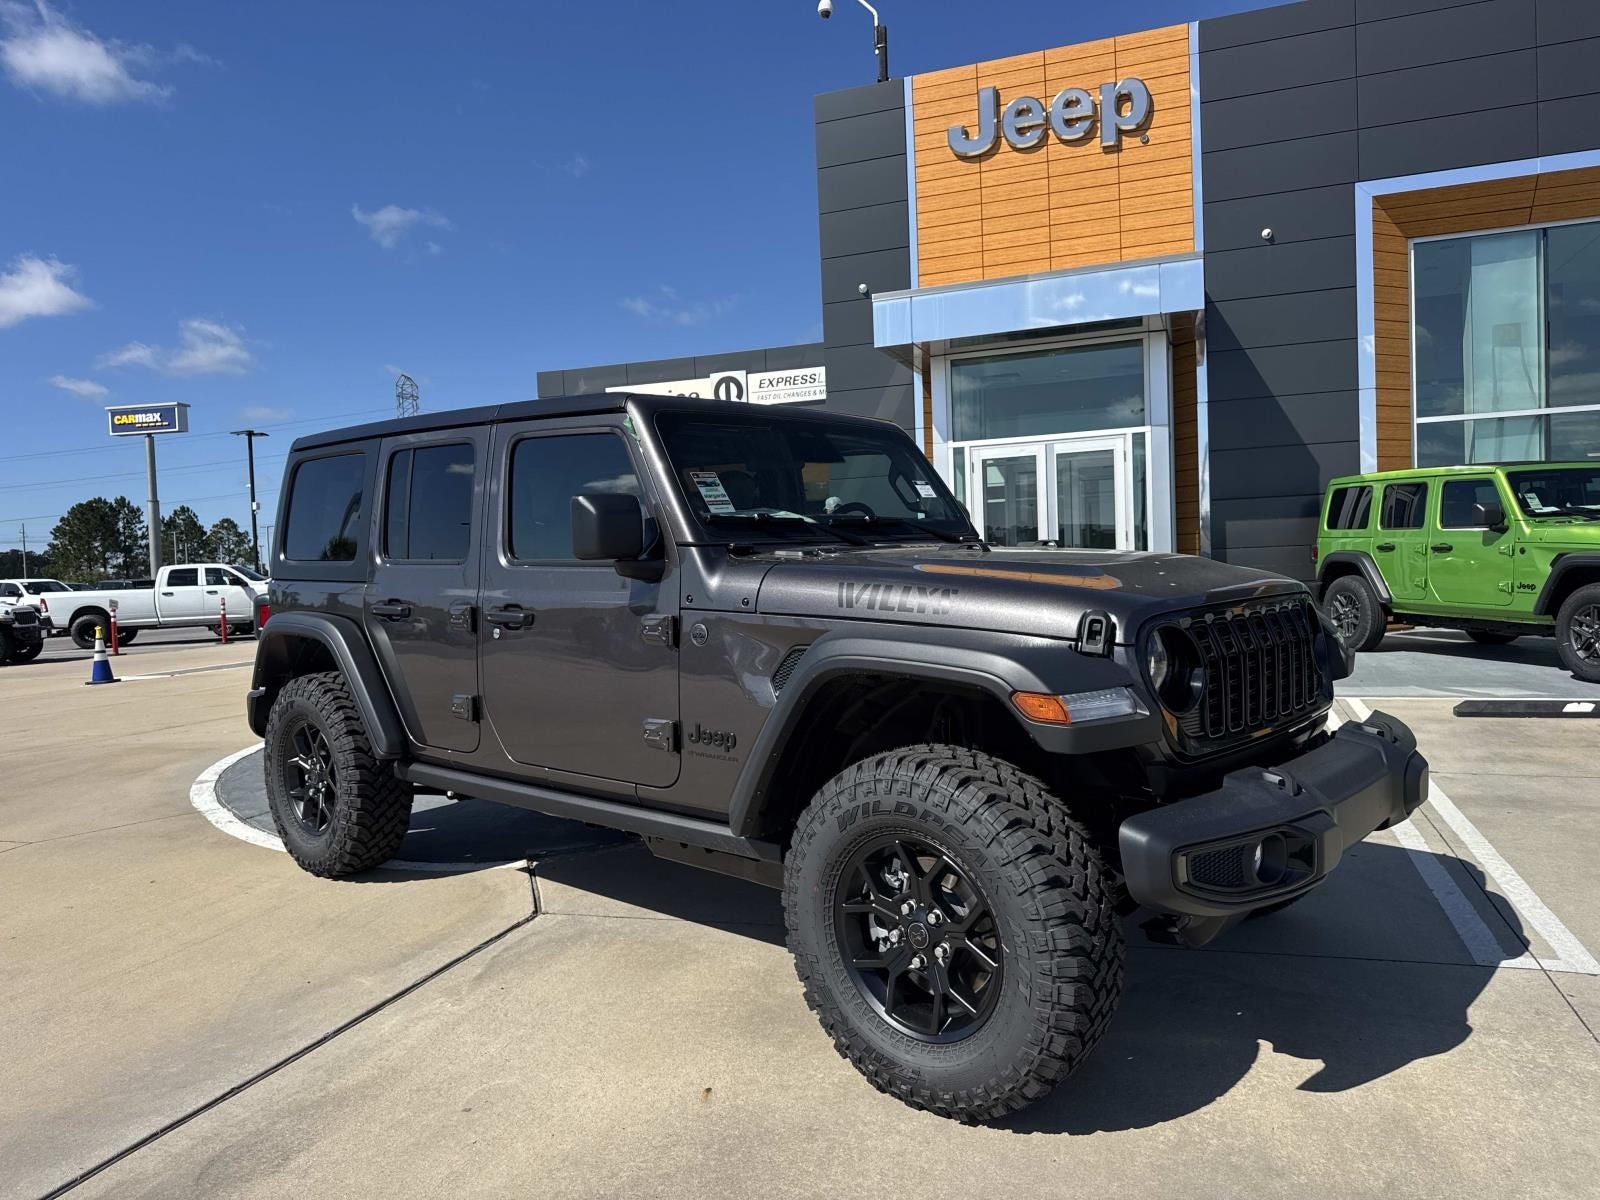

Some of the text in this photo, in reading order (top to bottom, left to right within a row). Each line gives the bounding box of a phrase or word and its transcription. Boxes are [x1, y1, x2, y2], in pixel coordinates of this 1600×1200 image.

[947, 77, 1150, 156] Jeep
[783, 386, 812, 399] CHANGES
[838, 582, 959, 615] WILLYS
[1516, 582, 1537, 591] Jeep
[687, 723, 737, 753] Jeep
